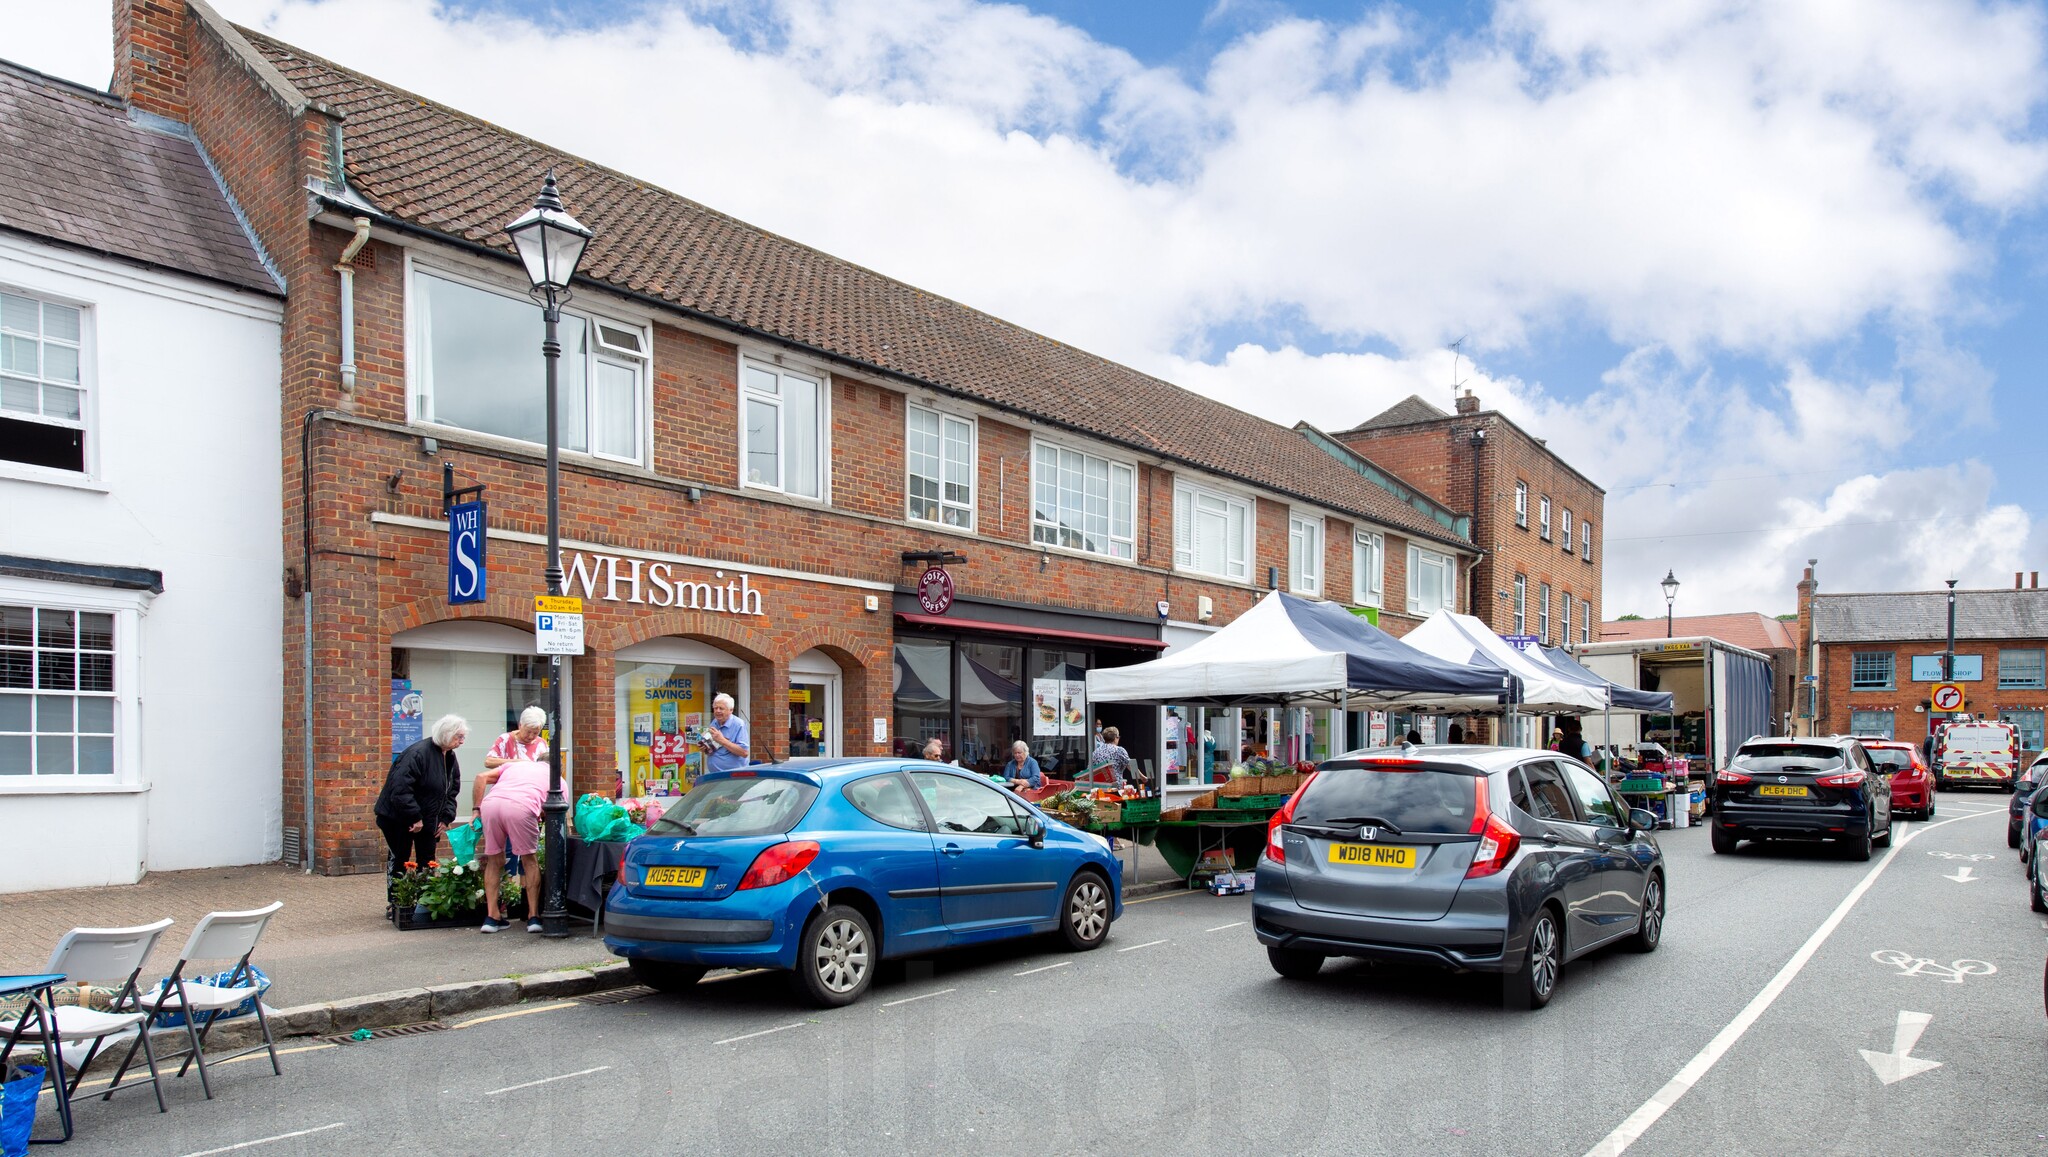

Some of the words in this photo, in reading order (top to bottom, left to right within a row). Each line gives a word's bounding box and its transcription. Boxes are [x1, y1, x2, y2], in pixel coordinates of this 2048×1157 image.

[456, 510, 478, 530] WH
[455, 530, 478, 598] S
[558, 550, 765, 616] WHSmith
[923, 571, 945, 585] COSTA
[922, 595, 948, 611] COFFEE
[542, 617, 551, 629] P
[645, 678, 692, 688] SUMMER
[645, 690, 693, 700] SAVINGS
[654, 736, 666, 753] 3
[672, 735, 685, 753] 2
[1763, 786, 1785, 795] PL64
[1787, 787, 1804, 795] DHC
[1339, 845, 1371, 862] WD18
[1375, 848, 1406, 864] NHO
[649, 868, 676, 883] KU56
[677, 869, 701, 884] EUP
